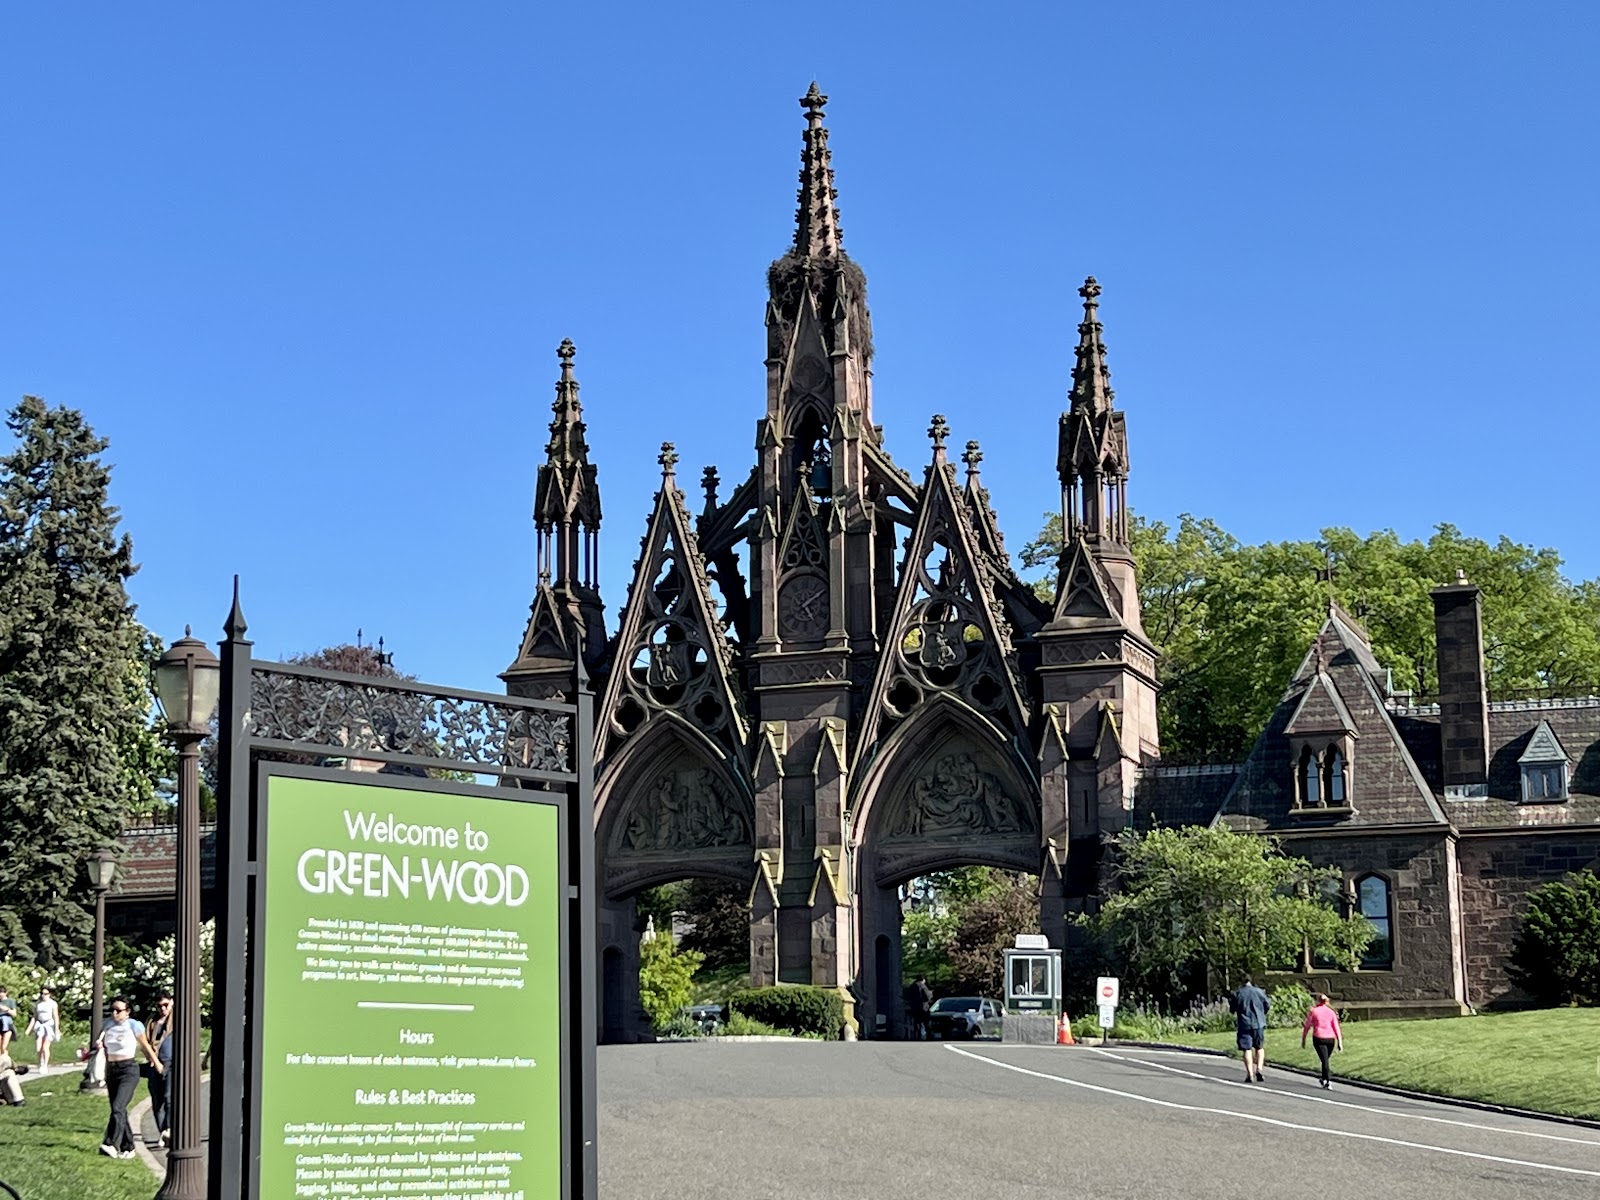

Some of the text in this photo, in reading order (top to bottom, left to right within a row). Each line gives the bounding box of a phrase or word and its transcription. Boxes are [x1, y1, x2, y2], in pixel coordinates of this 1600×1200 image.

[343, 810, 489, 851] Welcome to
[297, 849, 529, 906] GREEN-WOOD
[399, 1029, 435, 1044] Hours
[286, 1053, 301, 1064] For
[302, 1053, 316, 1064] the
[317, 1056, 348, 1064] current
[349, 1054, 372, 1065] hours
[373, 1054, 383, 1065] of
[383, 1055, 402, 1065] each
[440, 1055, 456, 1066] visit
[355, 1089, 475, 1106] Rules & Best Practices
